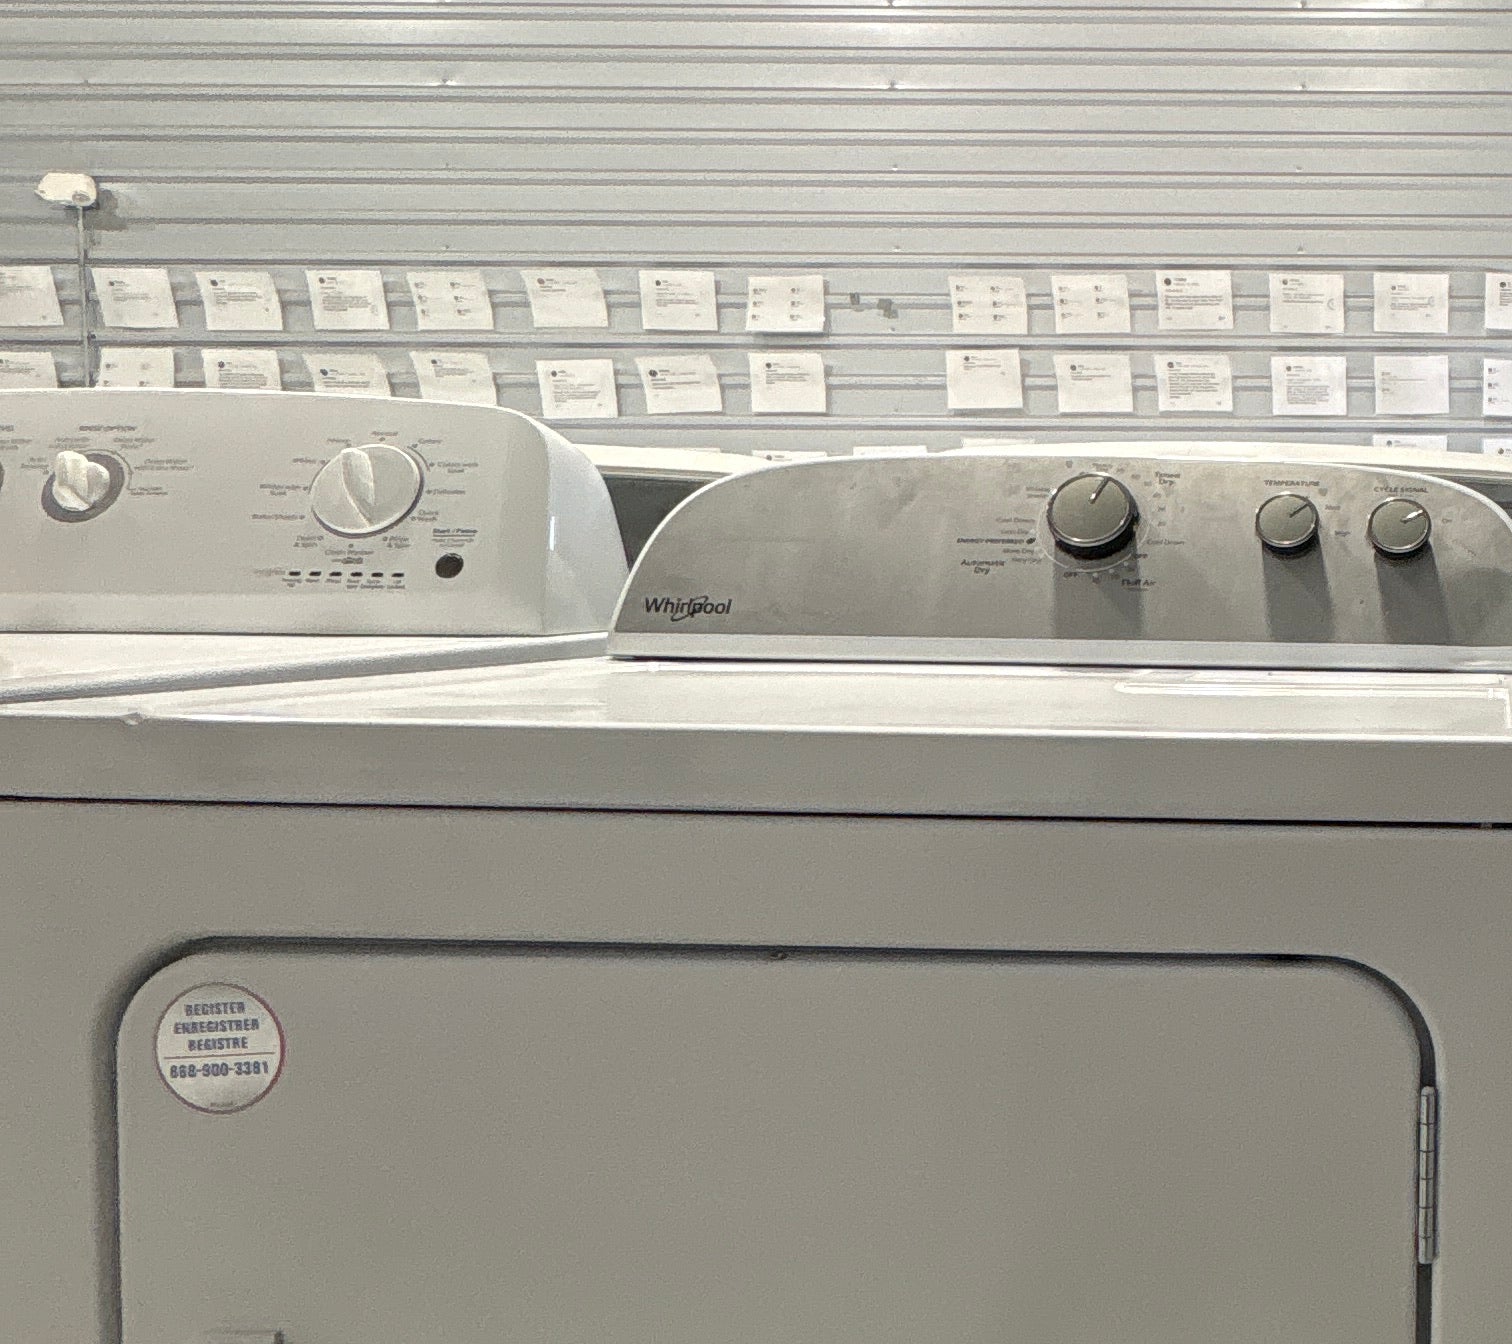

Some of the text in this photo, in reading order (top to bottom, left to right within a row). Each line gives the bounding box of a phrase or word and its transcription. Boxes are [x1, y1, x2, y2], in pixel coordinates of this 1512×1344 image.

[1264, 479, 1320, 487] TEMPERATURE
[645, 597, 732, 618] Whirlpool
[185, 1001, 246, 1016] REGISTER
[173, 1018, 259, 1035] ENREGISTRER
[187, 1036, 248, 1051] REGISTRE
